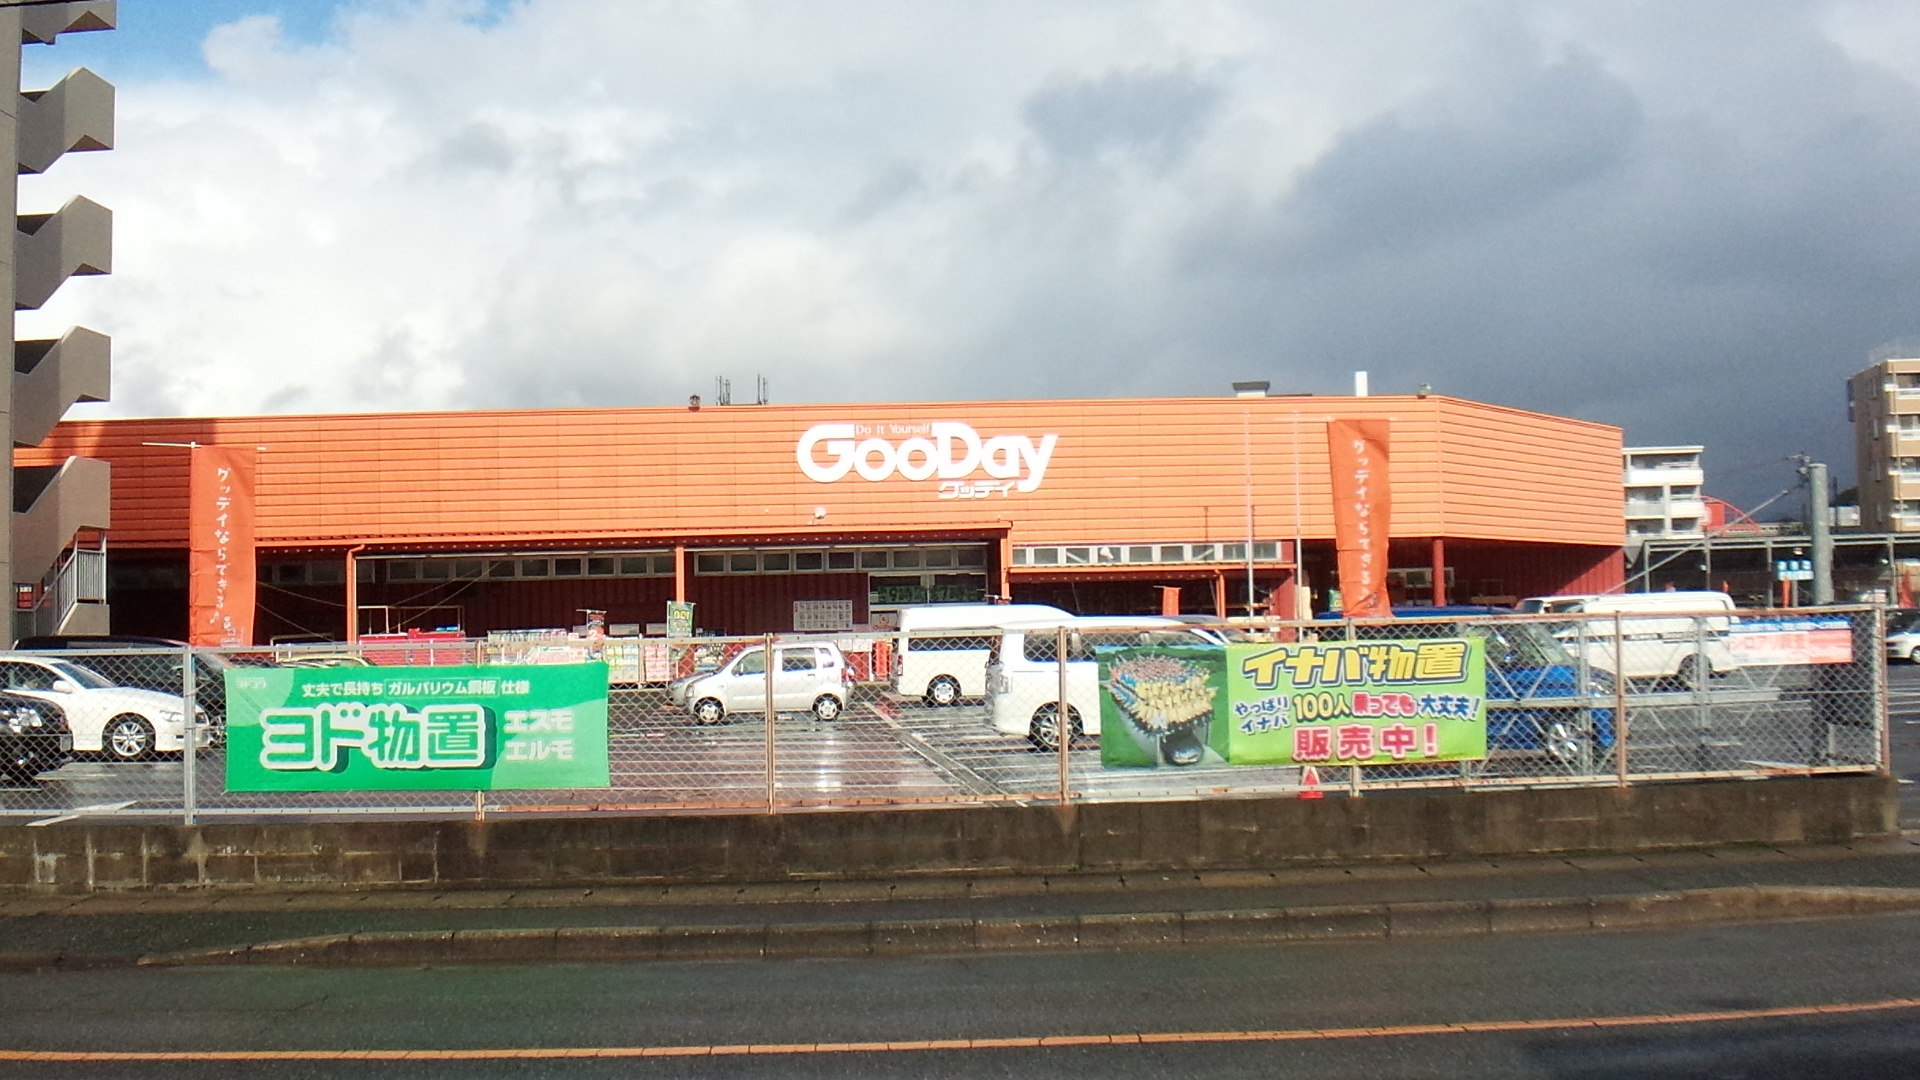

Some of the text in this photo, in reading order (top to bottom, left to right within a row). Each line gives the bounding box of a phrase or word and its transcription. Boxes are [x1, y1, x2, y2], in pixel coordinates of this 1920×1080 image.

[856, 423, 931, 435] Do It Yourself
[797, 421, 1059, 493] GooDay
[1242, 641, 1469, 689] イナバ物置
[302, 680, 530, 698] 丈夫で長持ち ガルバリウム鋼板 仕様
[1234, 696, 1290, 717] やっぱり
[503, 709, 574, 733] エスモ
[1240, 713, 1291, 735] イナバ
[260, 702, 486, 771] ヨド物置
[505, 739, 574, 761] エルモ
